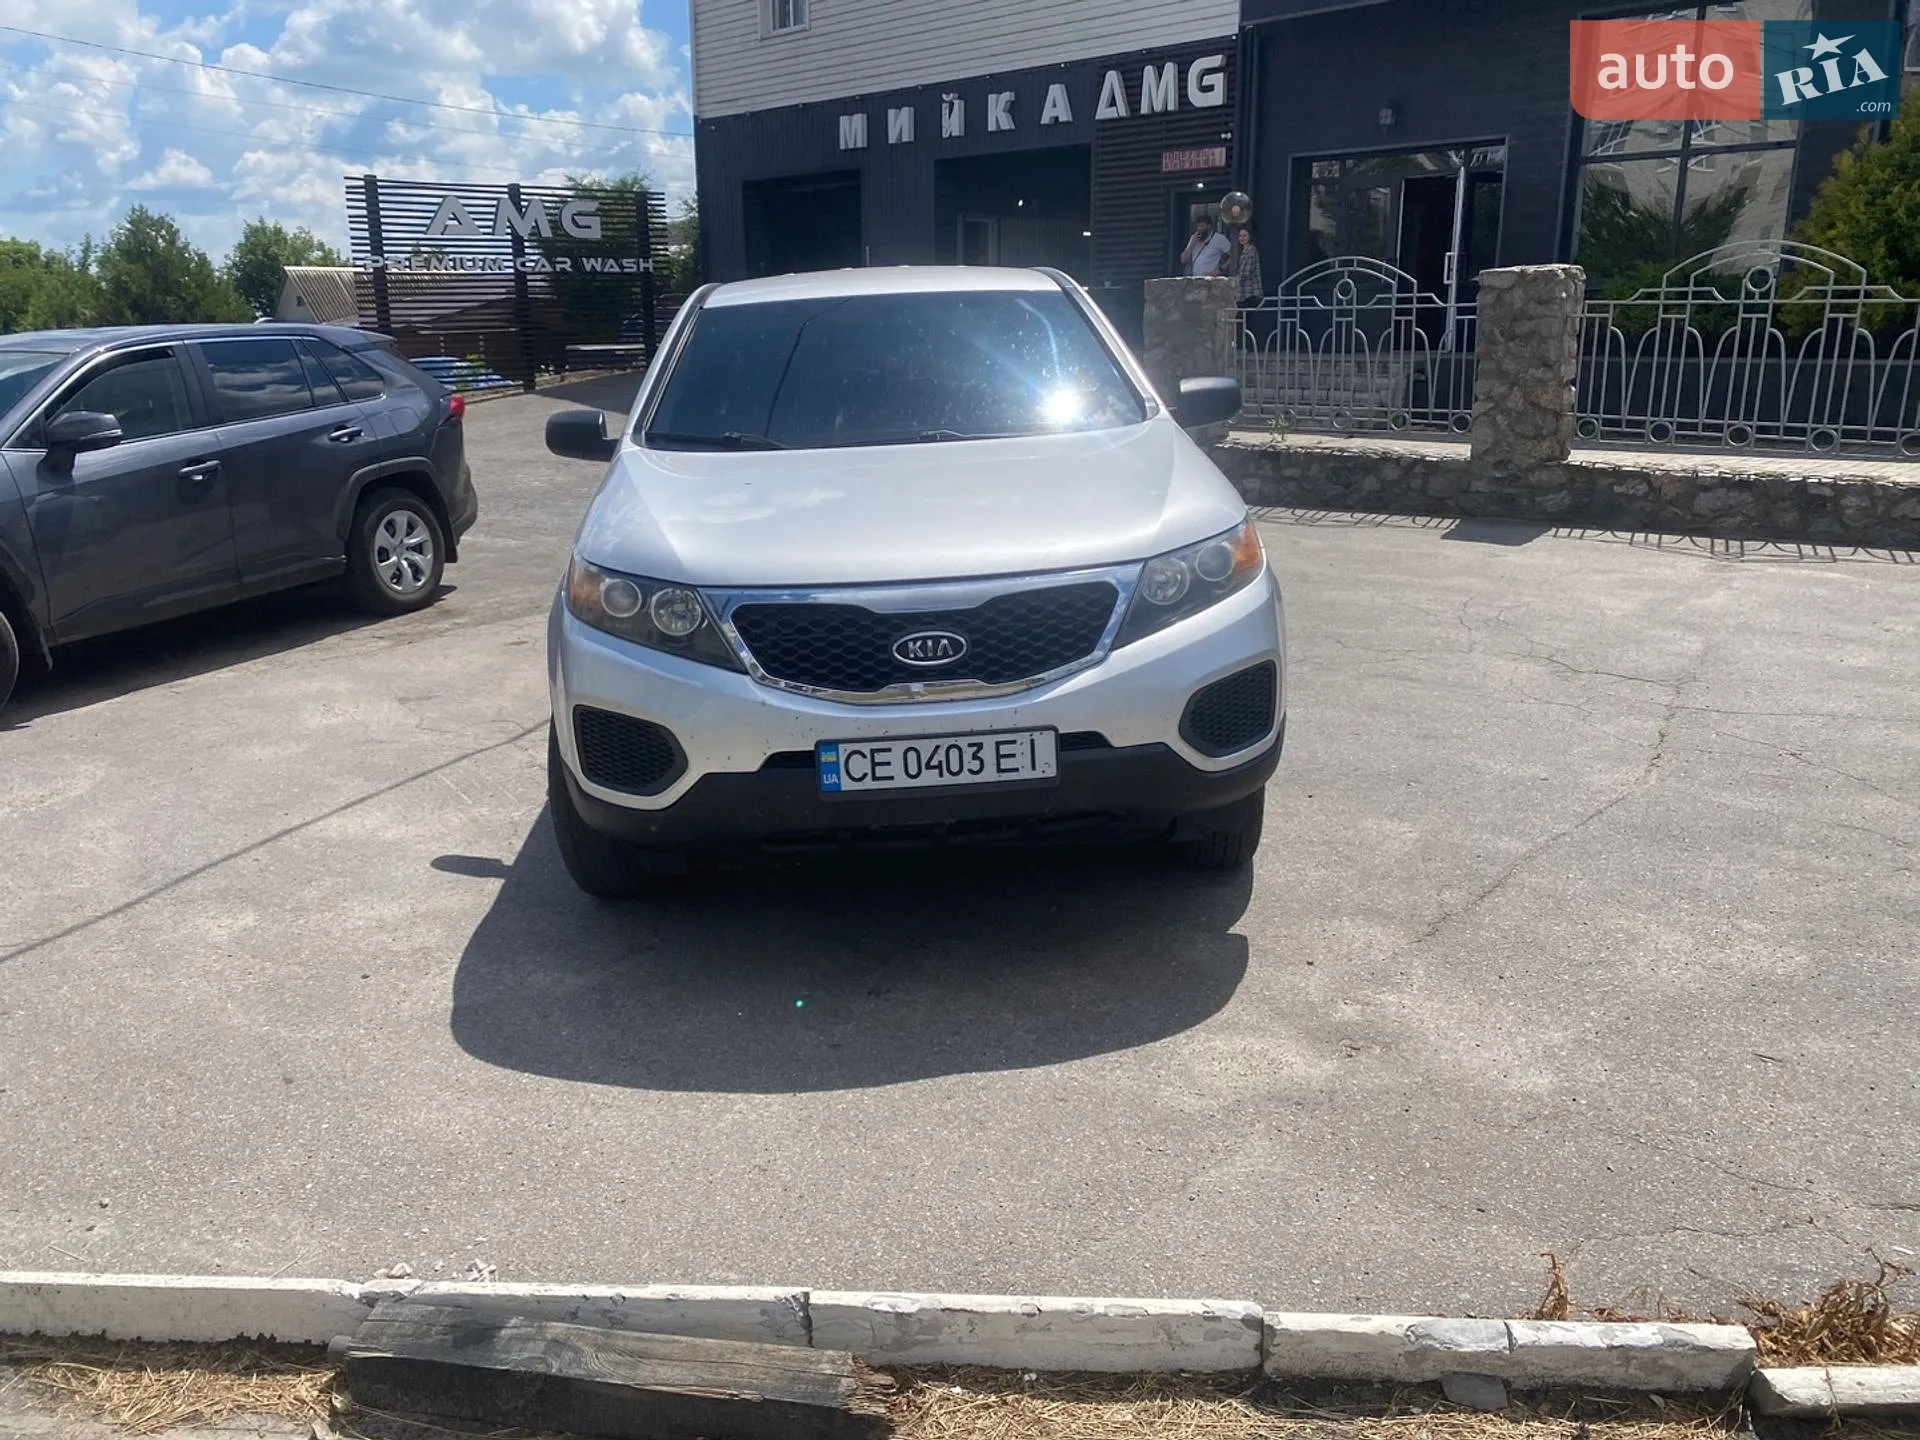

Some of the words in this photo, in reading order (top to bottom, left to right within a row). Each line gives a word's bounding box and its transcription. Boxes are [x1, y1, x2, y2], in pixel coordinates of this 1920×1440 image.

[839, 83, 1074, 150] МИЙКА
[425, 194, 601, 239] AMG
[363, 254, 506, 272] PREMIUM
[515, 256, 573, 273] CAR
[583, 257, 654, 273] WASH
[907, 638, 953, 658] KIA
[823, 773, 839, 785] UA
[844, 747, 894, 783] CE
[902, 741, 986, 780] 0403
[995, 737, 1037, 774] EI
